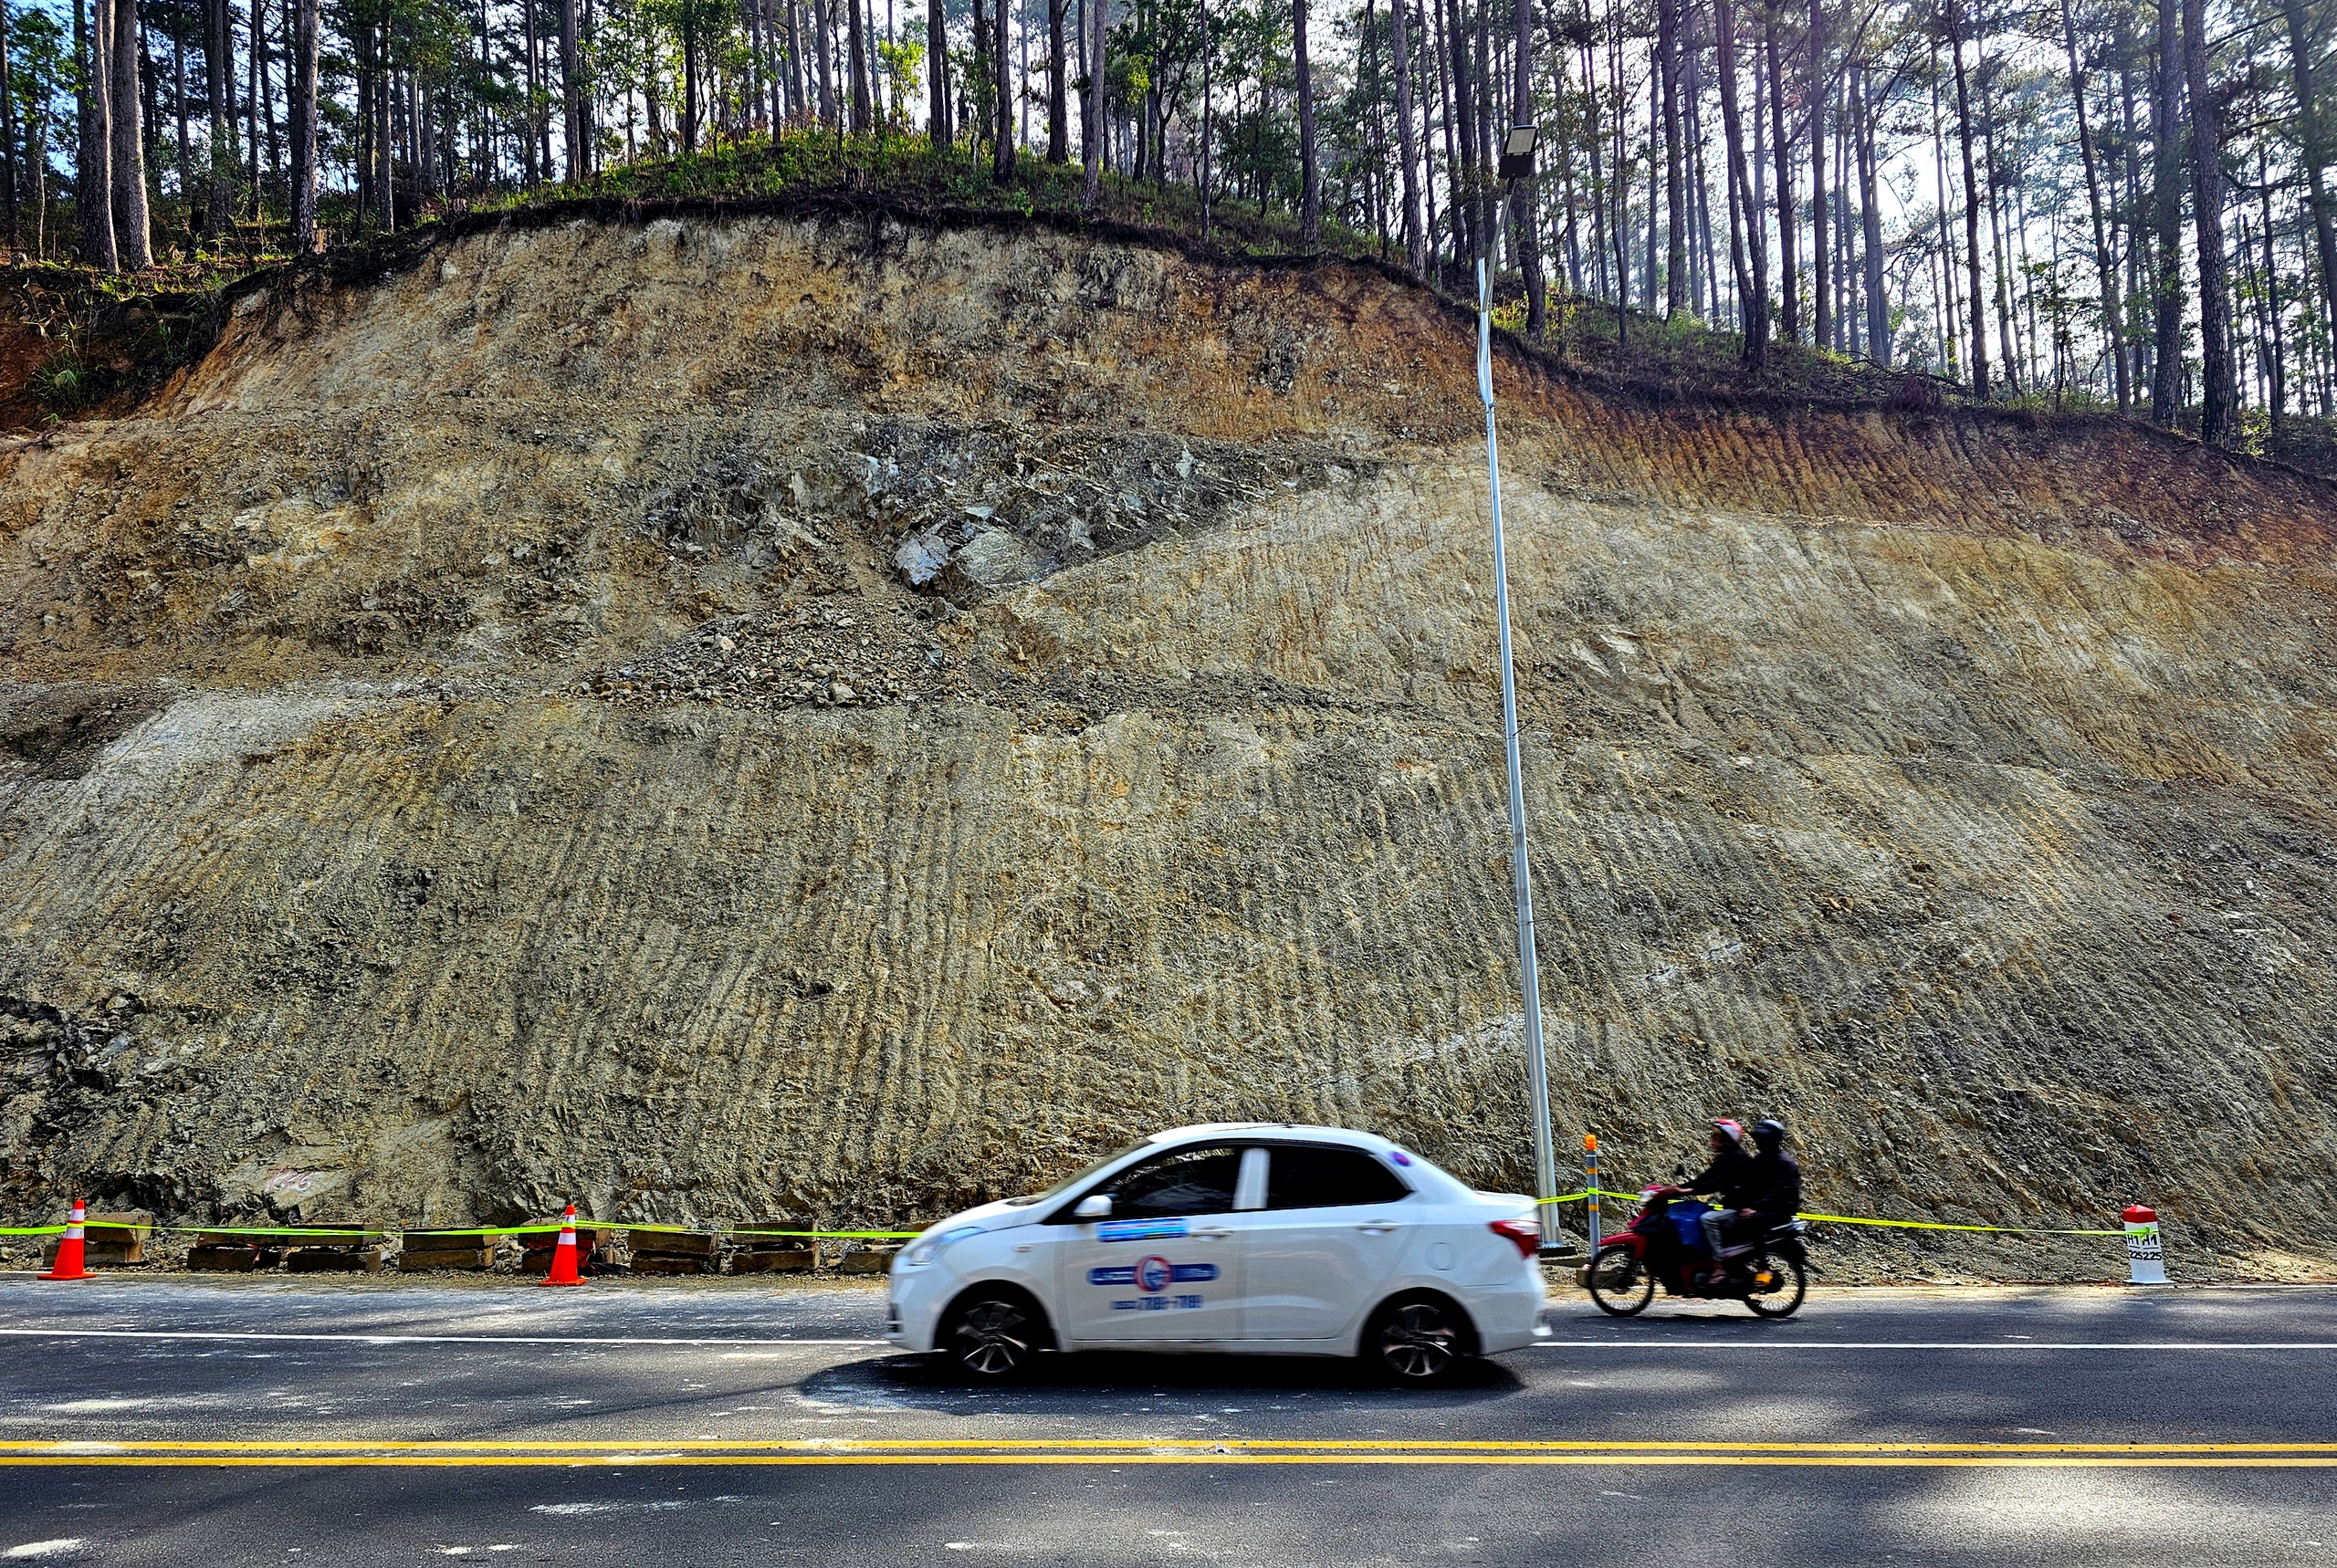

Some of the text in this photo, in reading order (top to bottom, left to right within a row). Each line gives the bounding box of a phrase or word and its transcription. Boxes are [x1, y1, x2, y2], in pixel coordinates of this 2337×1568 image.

[2128, 1235, 2139, 1245] H1
[2142, 1234, 2157, 1245] H1
[2129, 1249, 2143, 1260] 225
[2143, 1251, 2162, 1260] 225
